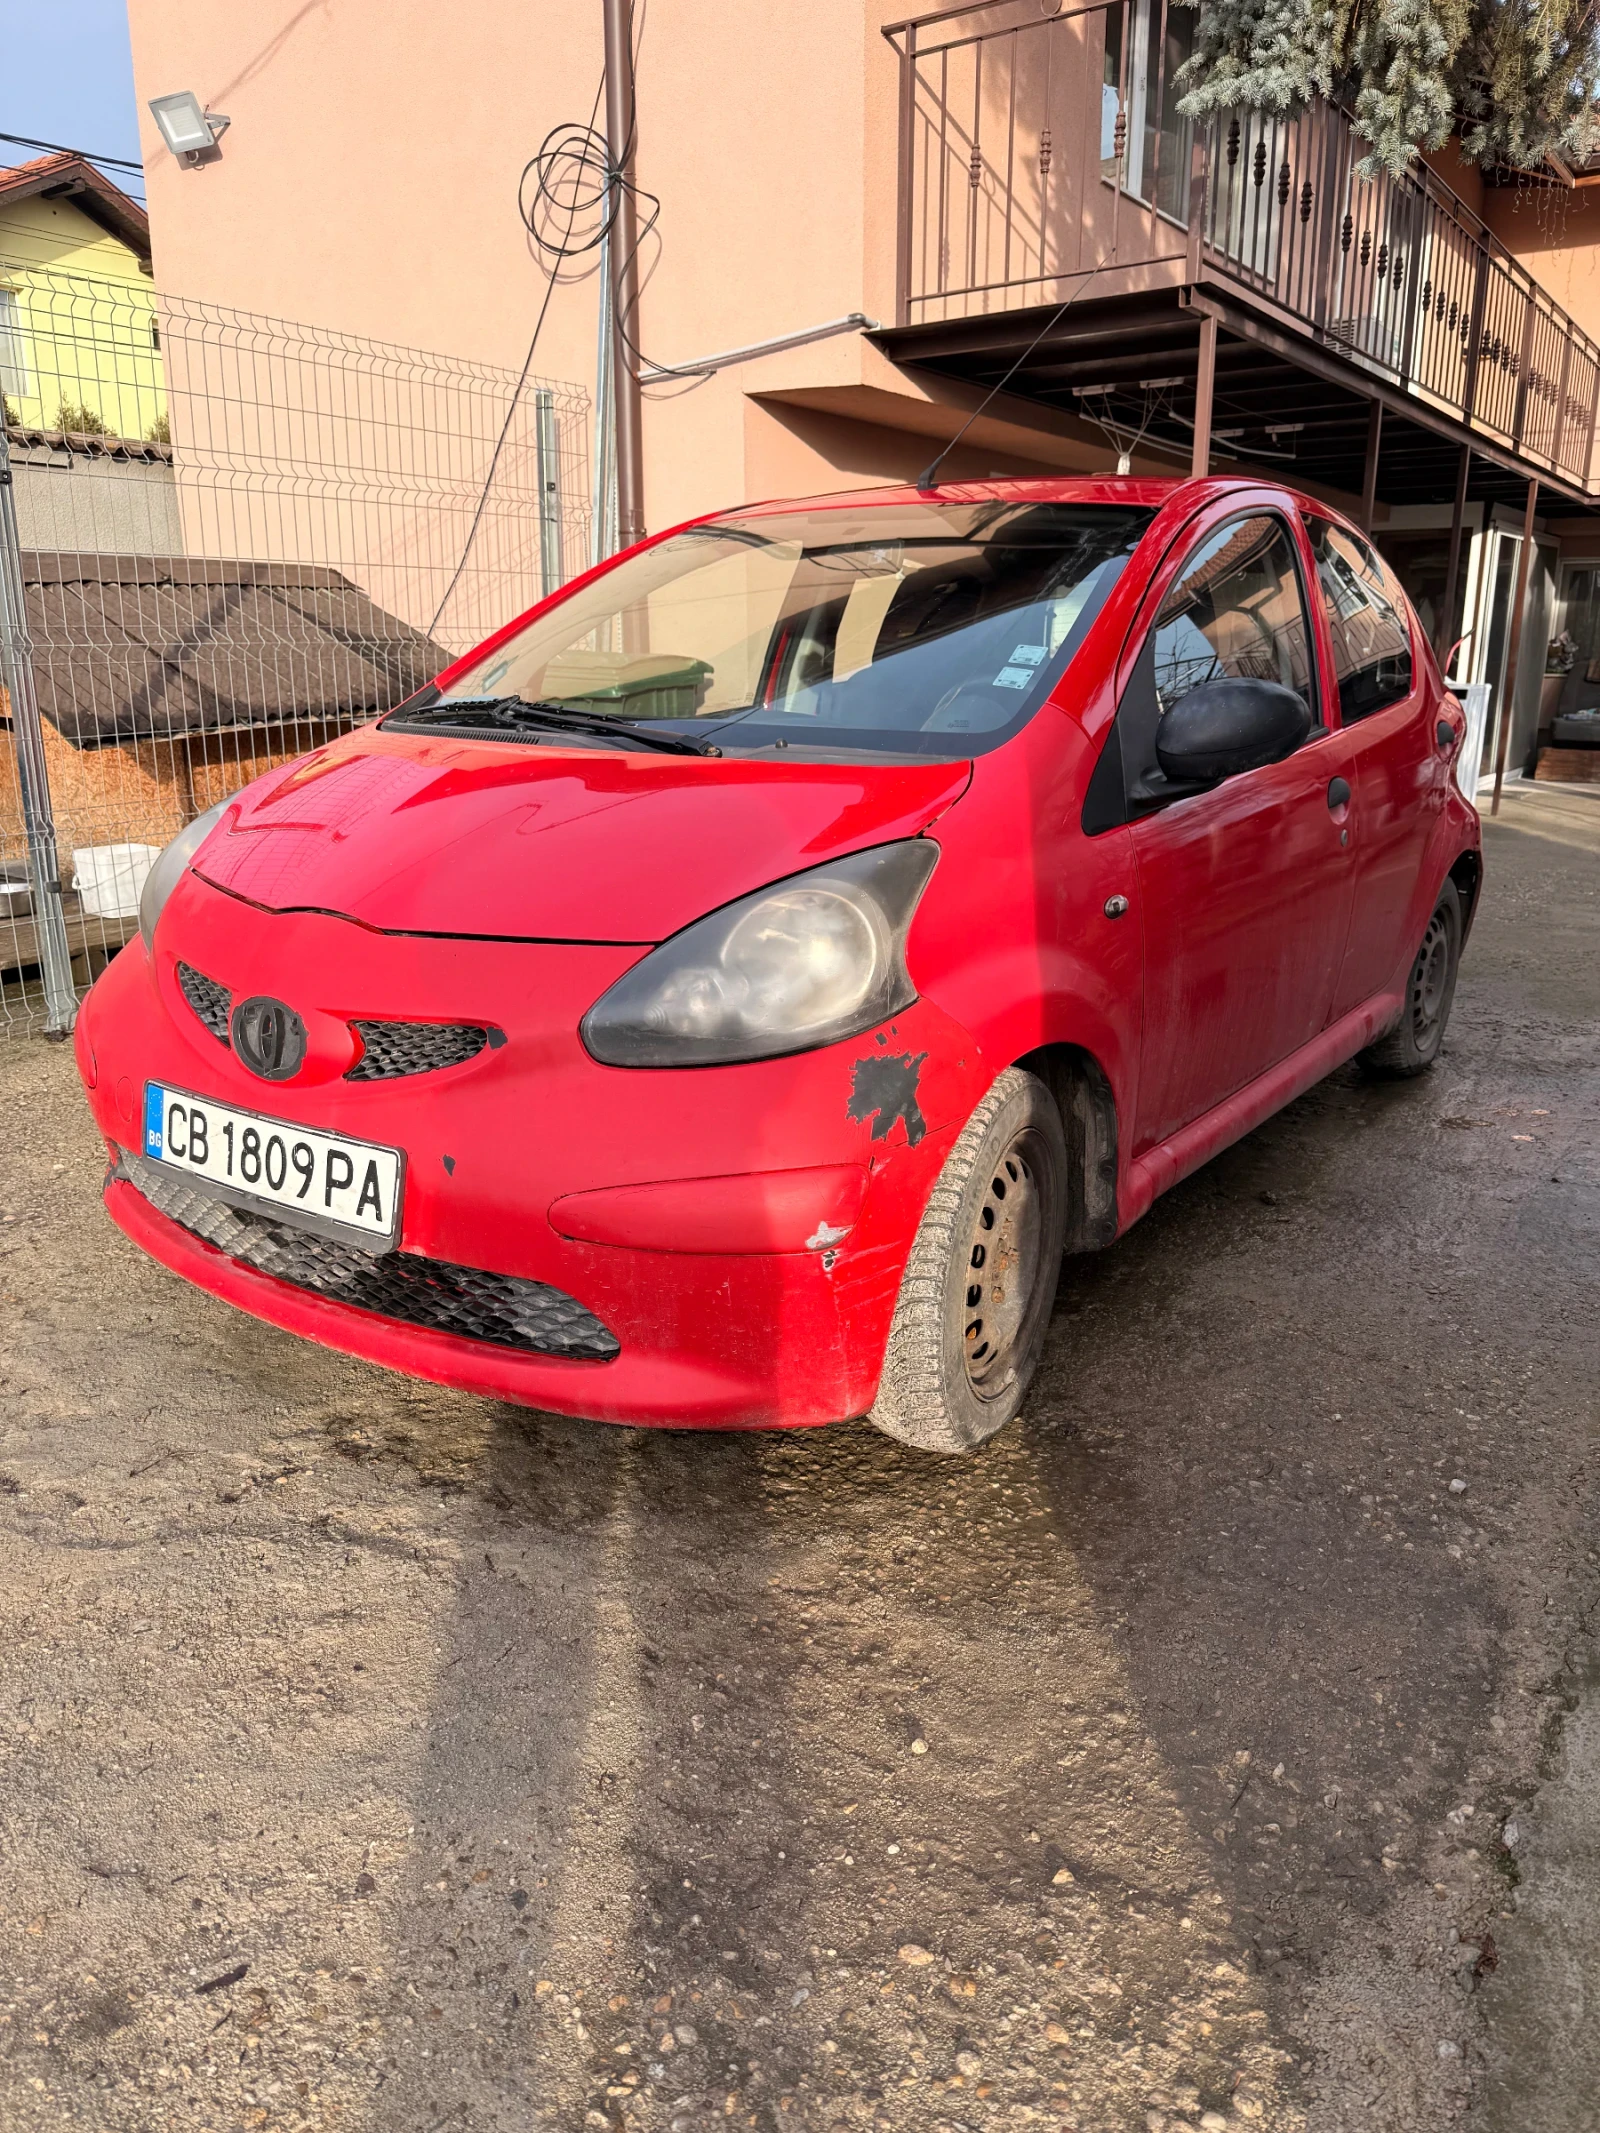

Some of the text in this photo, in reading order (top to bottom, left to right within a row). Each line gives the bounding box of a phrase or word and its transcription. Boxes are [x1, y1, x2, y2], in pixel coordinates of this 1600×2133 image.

[148, 1129, 162, 1148] BG
[167, 1103, 383, 1222] CB 1809 PA
